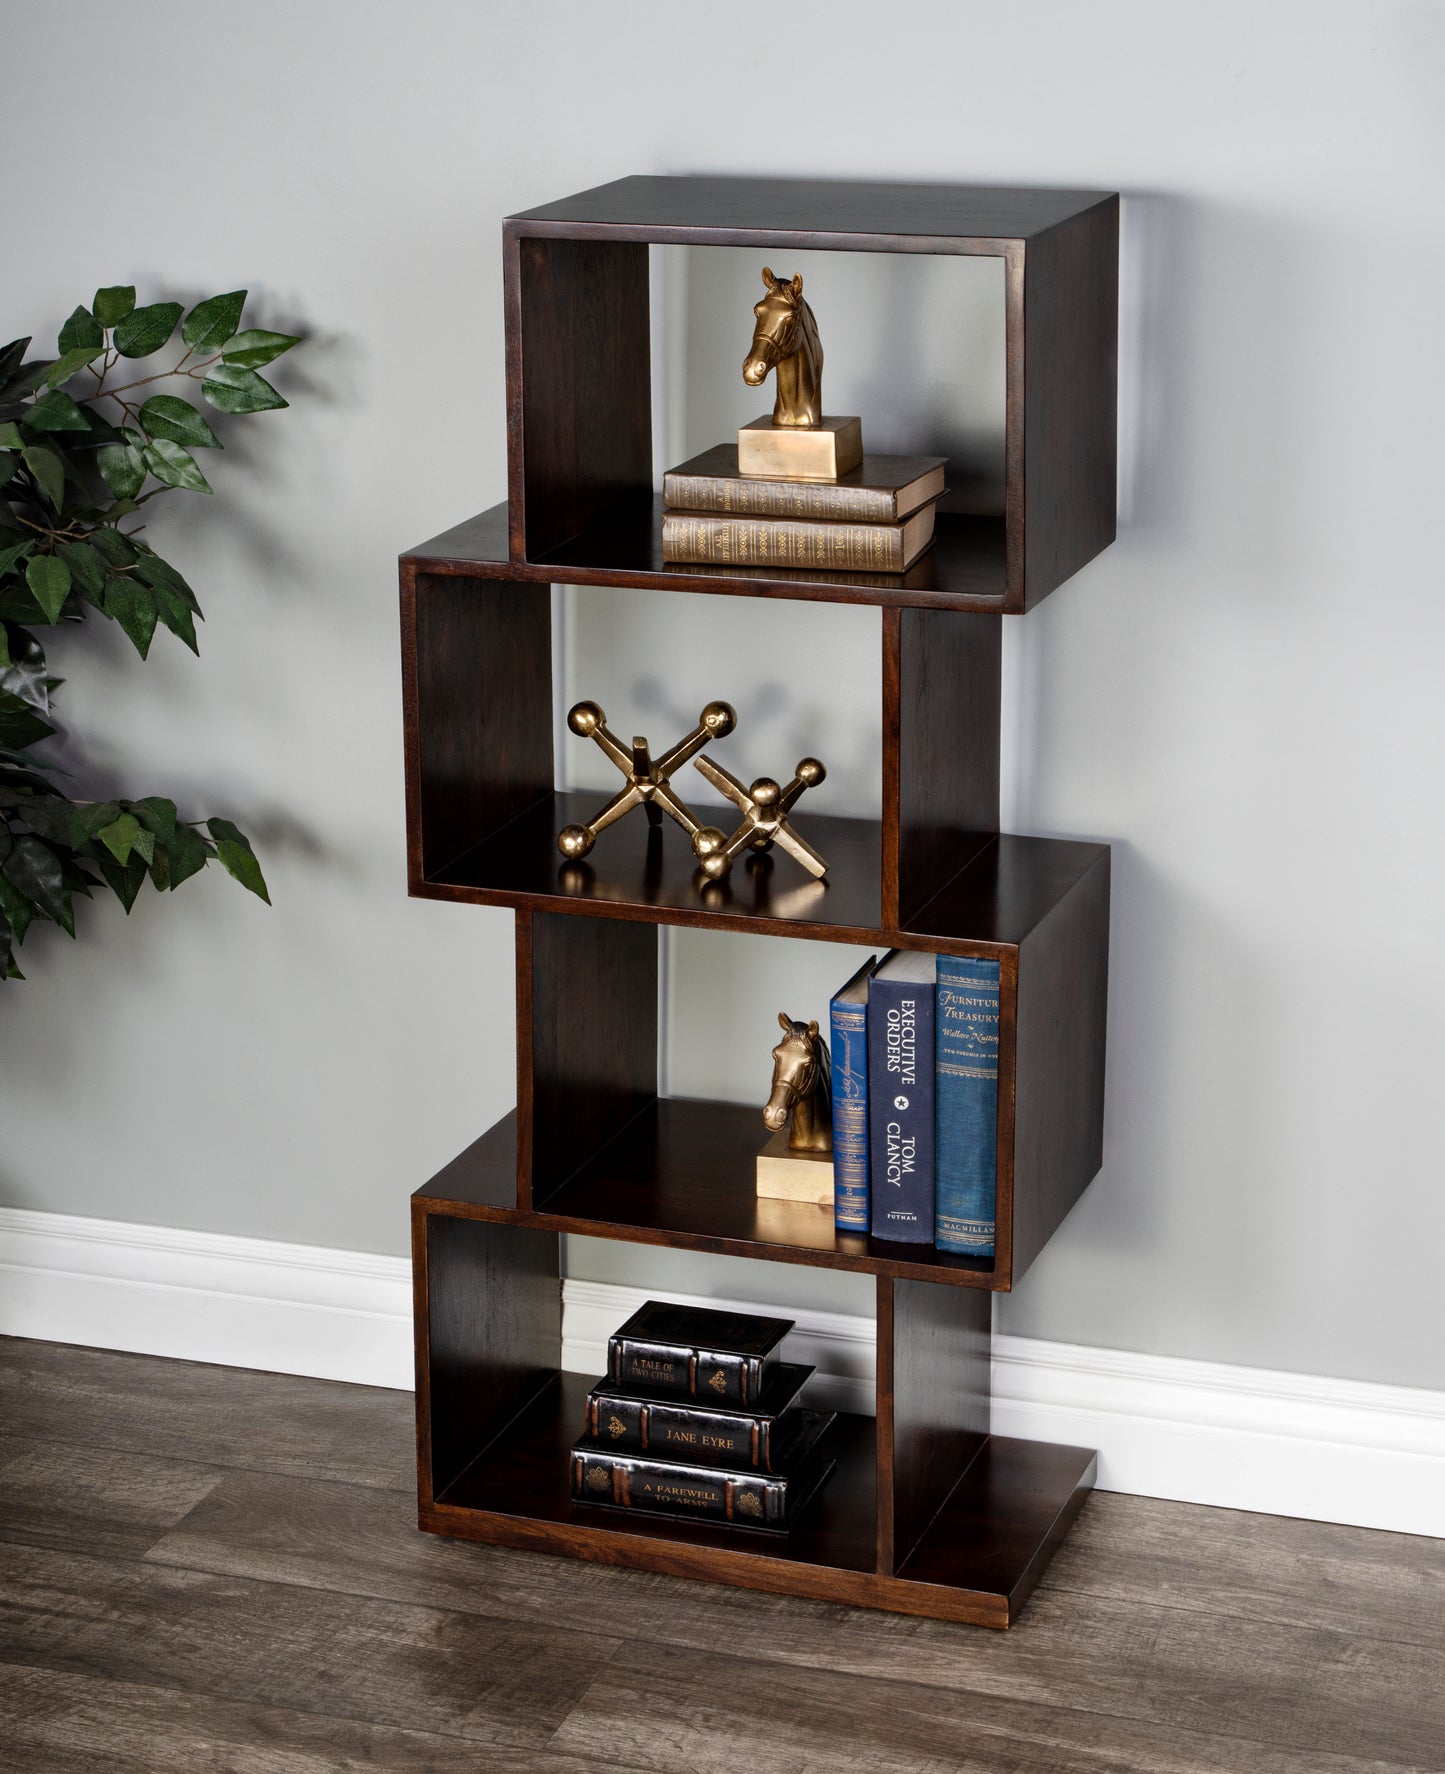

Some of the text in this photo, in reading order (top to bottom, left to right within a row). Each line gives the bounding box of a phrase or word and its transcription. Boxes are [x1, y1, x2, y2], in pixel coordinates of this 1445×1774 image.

[938, 990, 999, 1008] FURNITUR
[887, 1008, 901, 1073] ORDERS
[901, 1000, 916, 1085] EXECUTIVE
[942, 1028, 970, 1039] Wallace
[887, 1122, 901, 1187] CLANCY
[901, 1136, 916, 1173] TOM
[887, 1213, 918, 1221] PUTNAM
[943, 1222, 996, 1234] MACMILLAN
[632, 1358, 675, 1372] A TALE OF
[632, 1367, 676, 1383] TWO CITIES
[666, 1429, 735, 1450] JANE EYRE
[643, 1483, 719, 1501] A FAREWELL
[655, 1494, 709, 1508] TO ARMS
